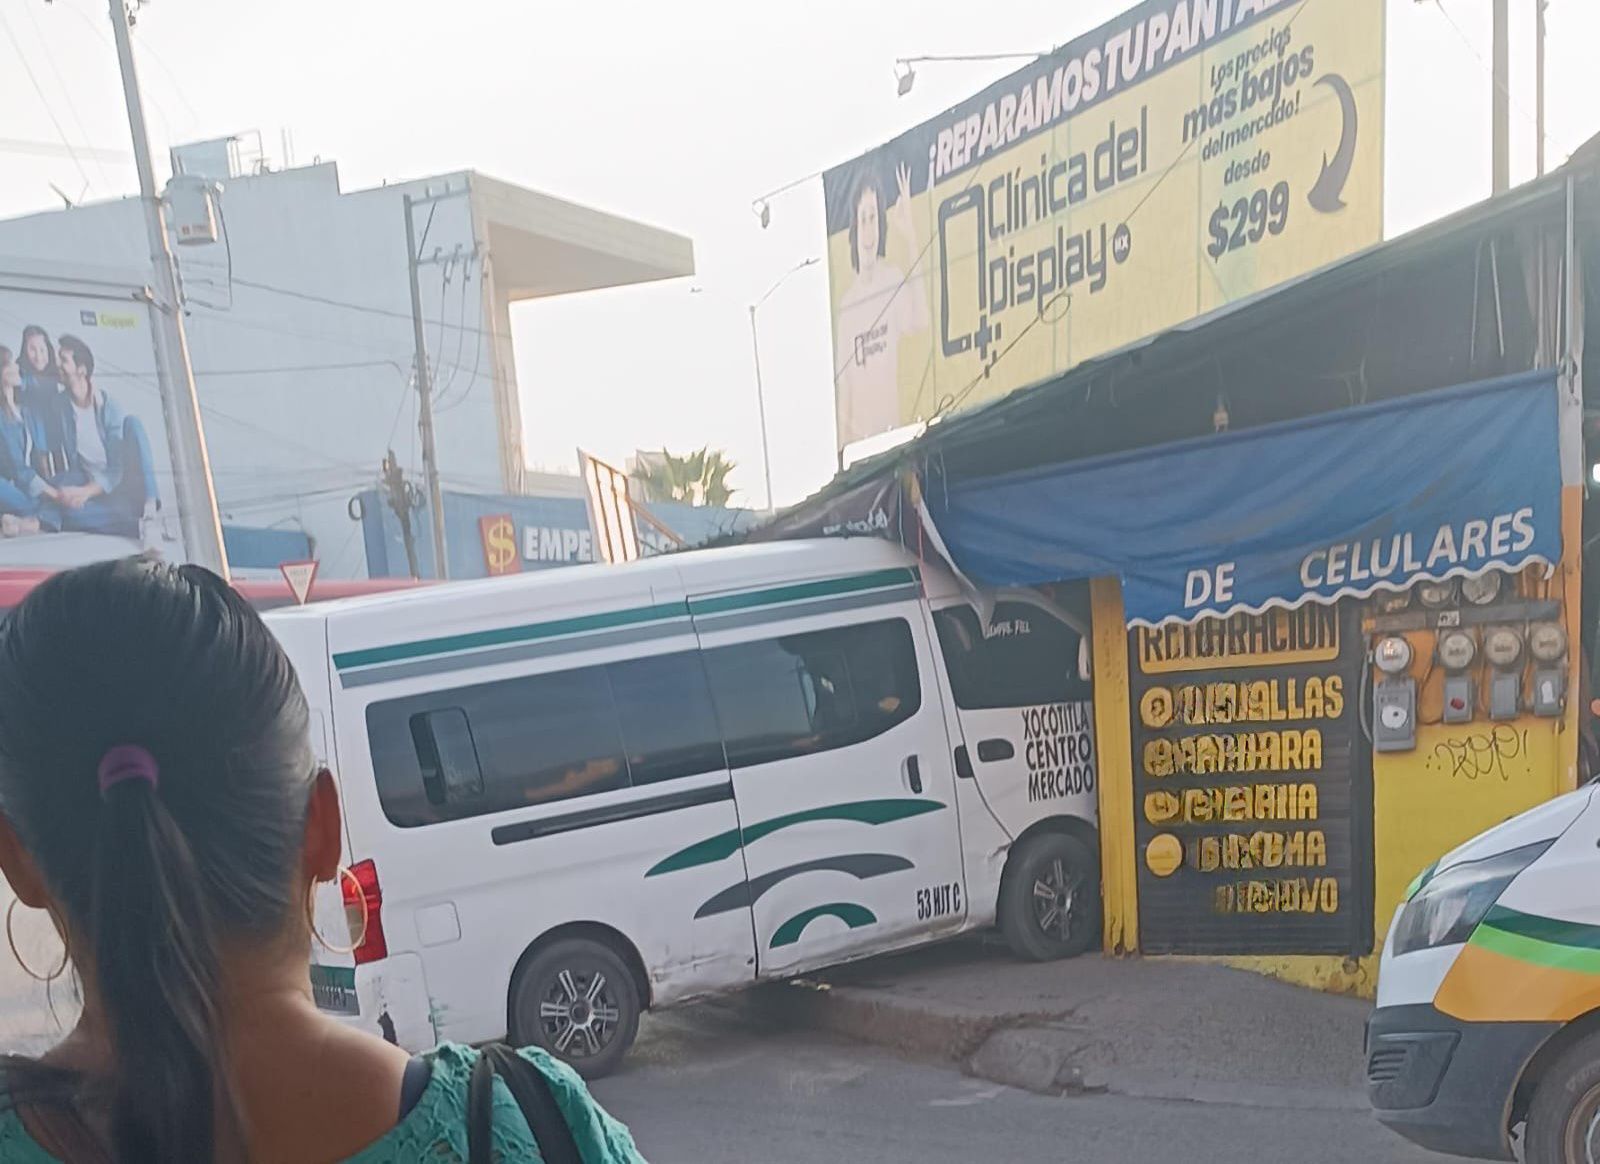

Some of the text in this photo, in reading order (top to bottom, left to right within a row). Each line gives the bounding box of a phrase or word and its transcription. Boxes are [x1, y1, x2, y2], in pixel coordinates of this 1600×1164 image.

[1104, 22, 1145, 92] TU
[1240, 45, 1314, 112] bajos
[1202, 130, 1226, 162] del
[988, 105, 1148, 240] Clínica del
[1223, 149, 1271, 186] desde
[1207, 181, 1290, 264] $299
[989, 223, 1107, 315] Display
[522, 525, 601, 563] EMPE
[1184, 507, 1535, 609] DE CELULARES
[1022, 701, 1089, 741] XOCOTITLA
[1026, 733, 1092, 771] CENTRO
[1028, 763, 1094, 803] MERCADO
[917, 888, 932, 920] 53
[953, 881, 961, 913] C
